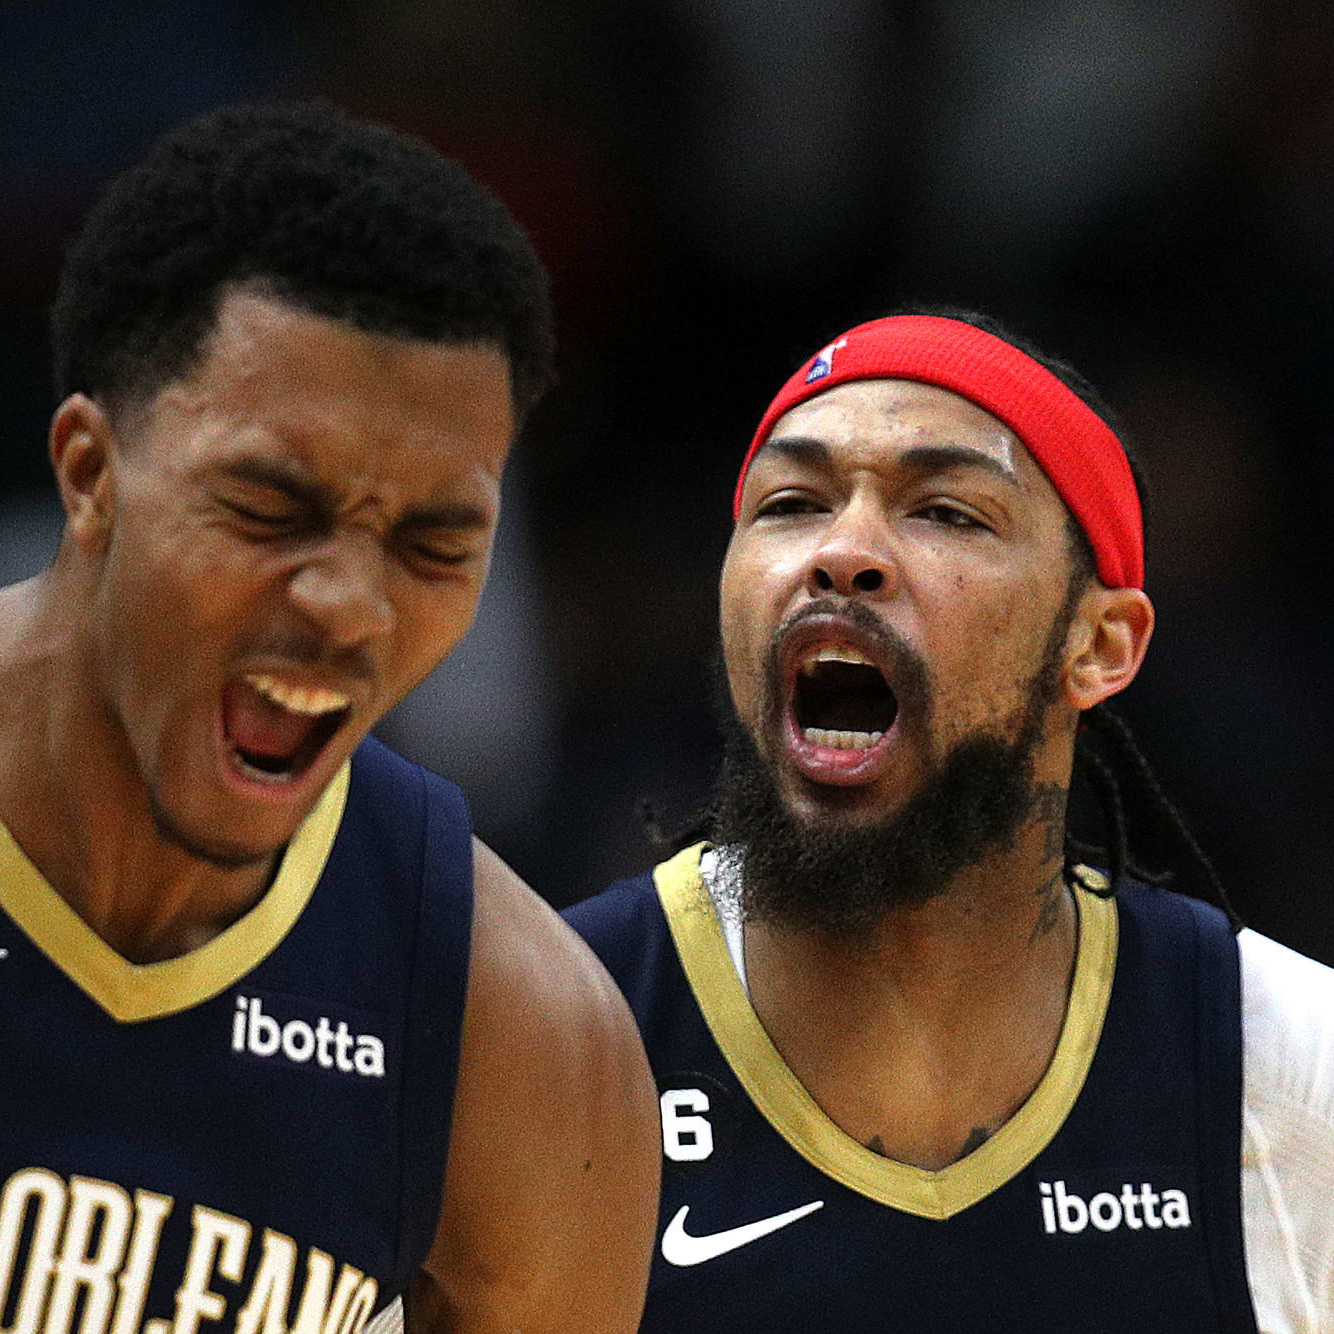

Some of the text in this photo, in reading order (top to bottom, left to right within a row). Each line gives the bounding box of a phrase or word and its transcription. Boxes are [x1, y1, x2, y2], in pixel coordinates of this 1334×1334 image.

[230, 994, 387, 1079] ibotta
[659, 1087, 714, 1162] 6
[1038, 1180, 1192, 1235] ibotta
